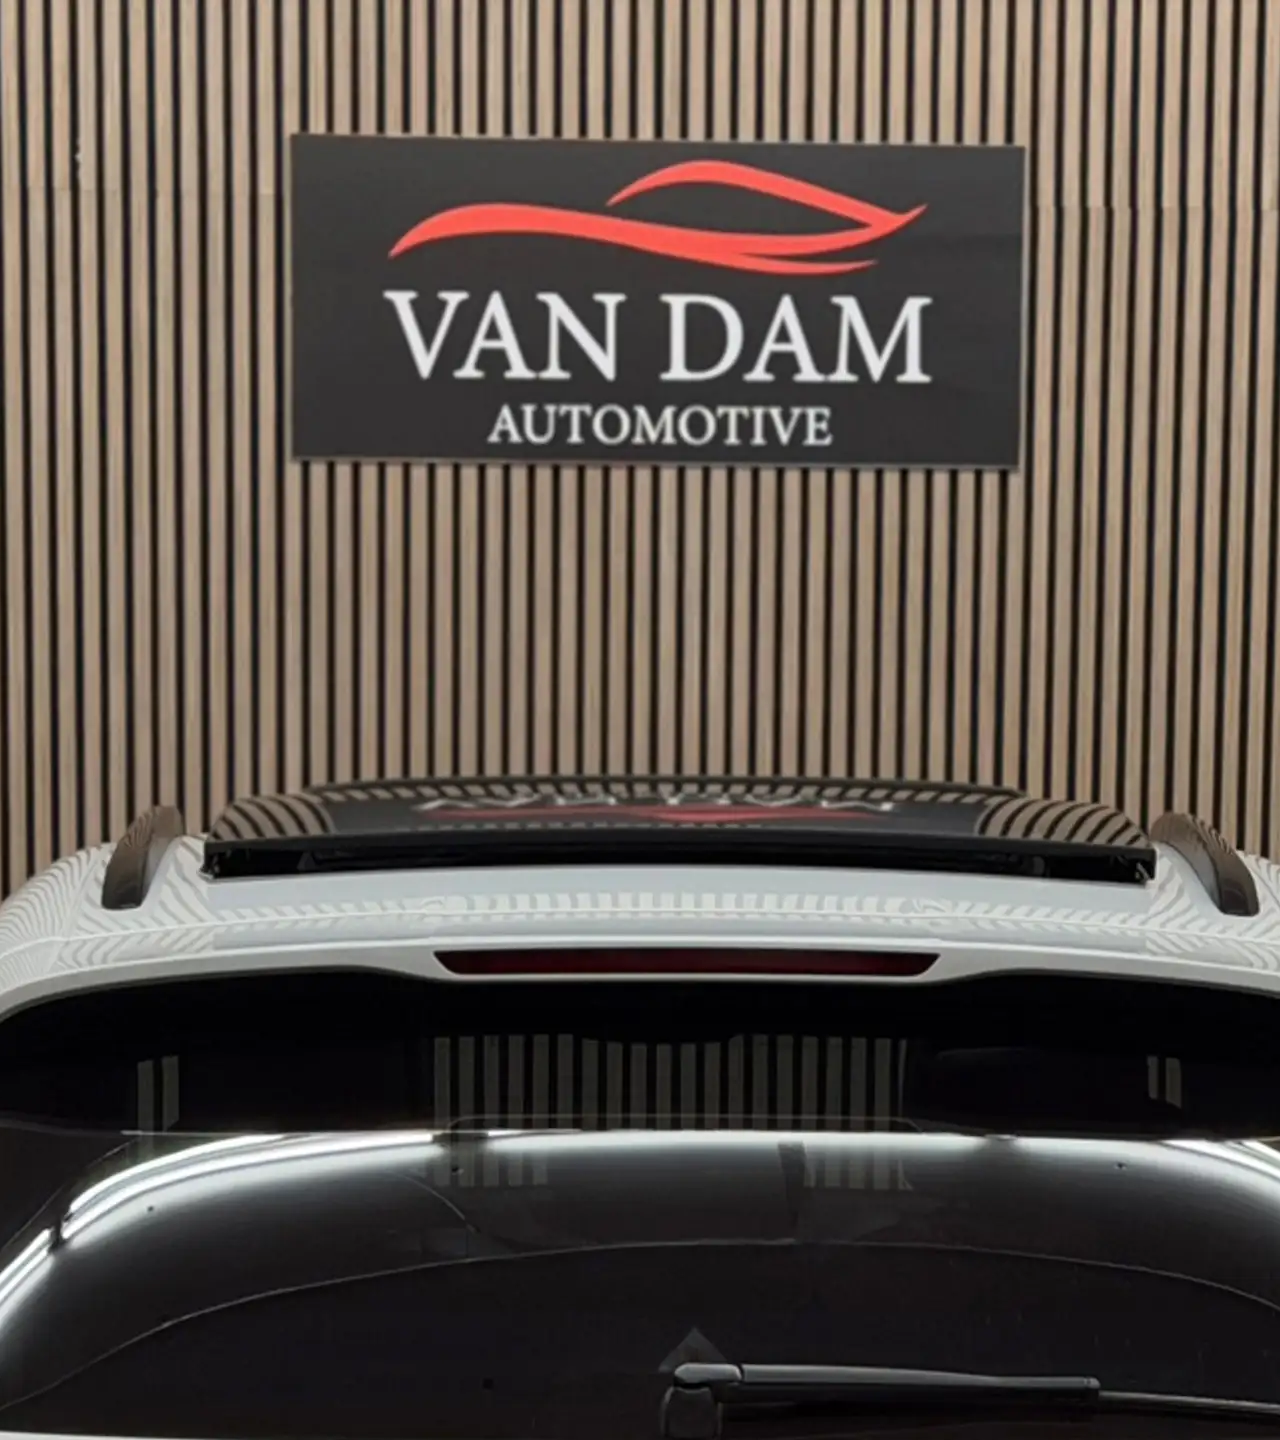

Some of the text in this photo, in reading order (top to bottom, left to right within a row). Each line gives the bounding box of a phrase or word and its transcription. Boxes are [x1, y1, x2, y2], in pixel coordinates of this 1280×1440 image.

[383, 290, 933, 383] VAN DAM
[487, 403, 833, 446] AUTOMOTIVE
